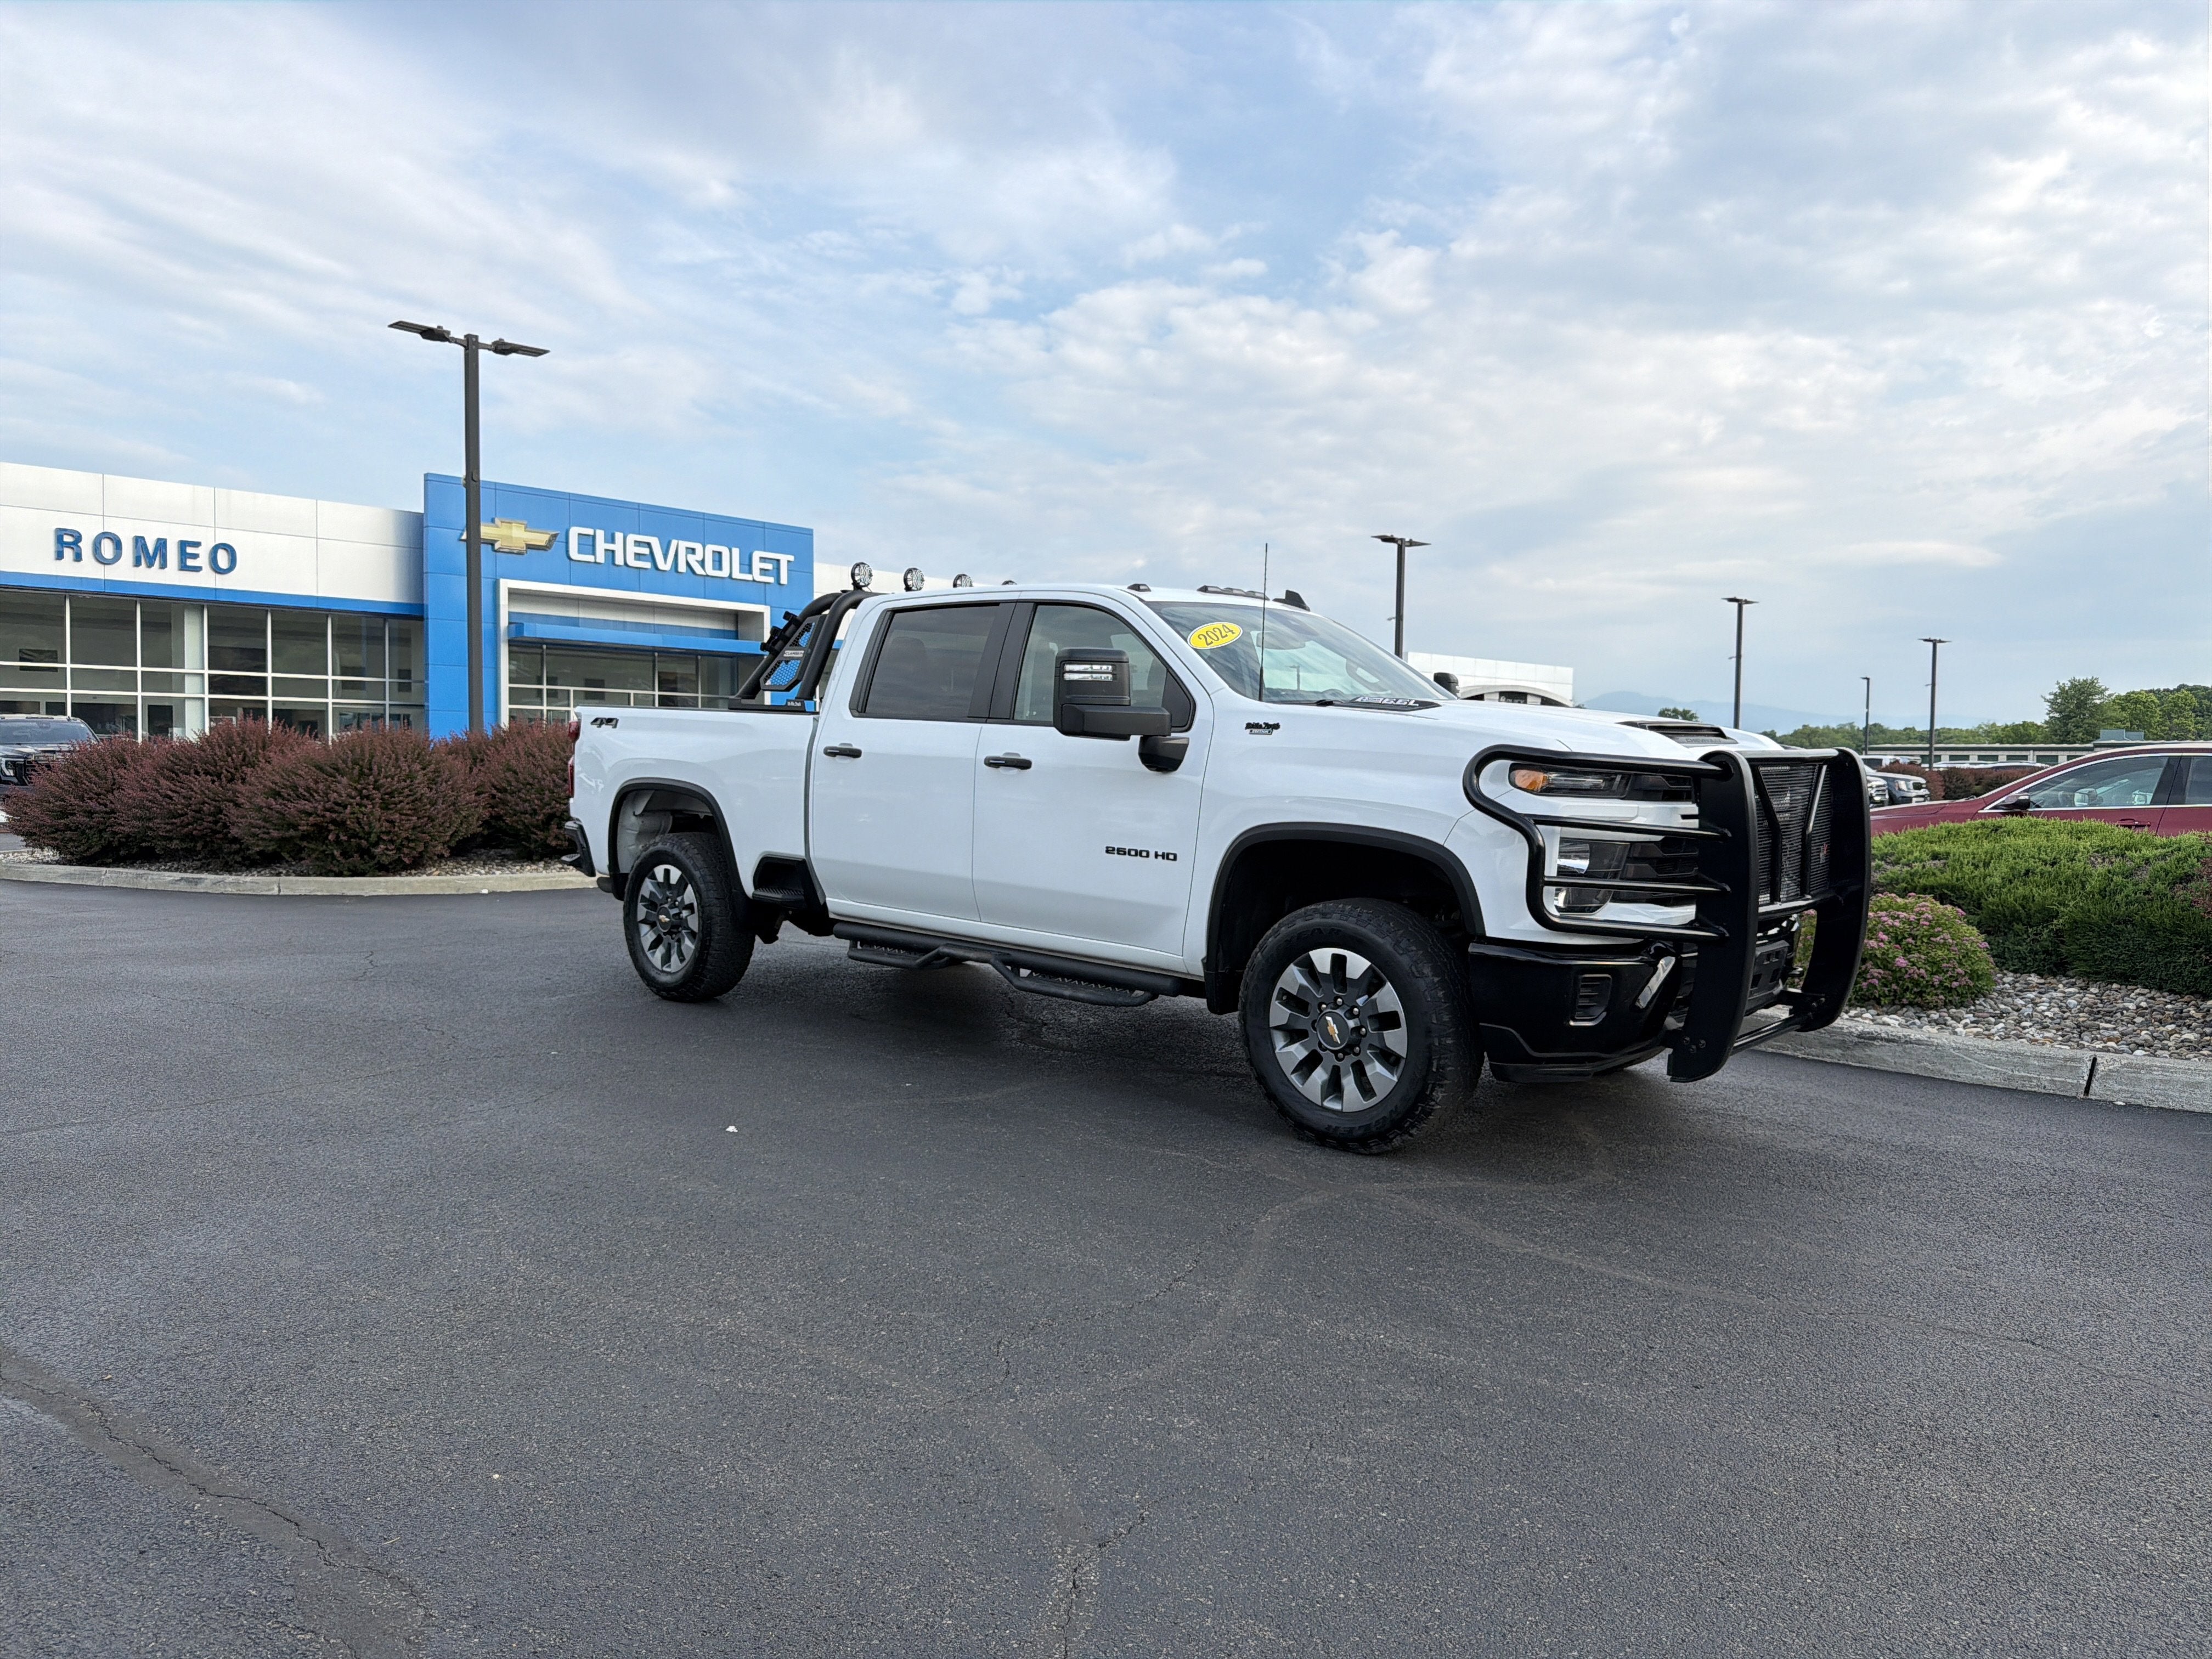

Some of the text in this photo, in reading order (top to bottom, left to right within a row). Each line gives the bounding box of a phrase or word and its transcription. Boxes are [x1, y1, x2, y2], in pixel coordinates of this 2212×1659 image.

[54, 527, 237, 574] ROMEO
[568, 526, 794, 585] CHEVROLET
[1198, 624, 1236, 646] 2024
[1105, 846, 1177, 861] 2500 HD
